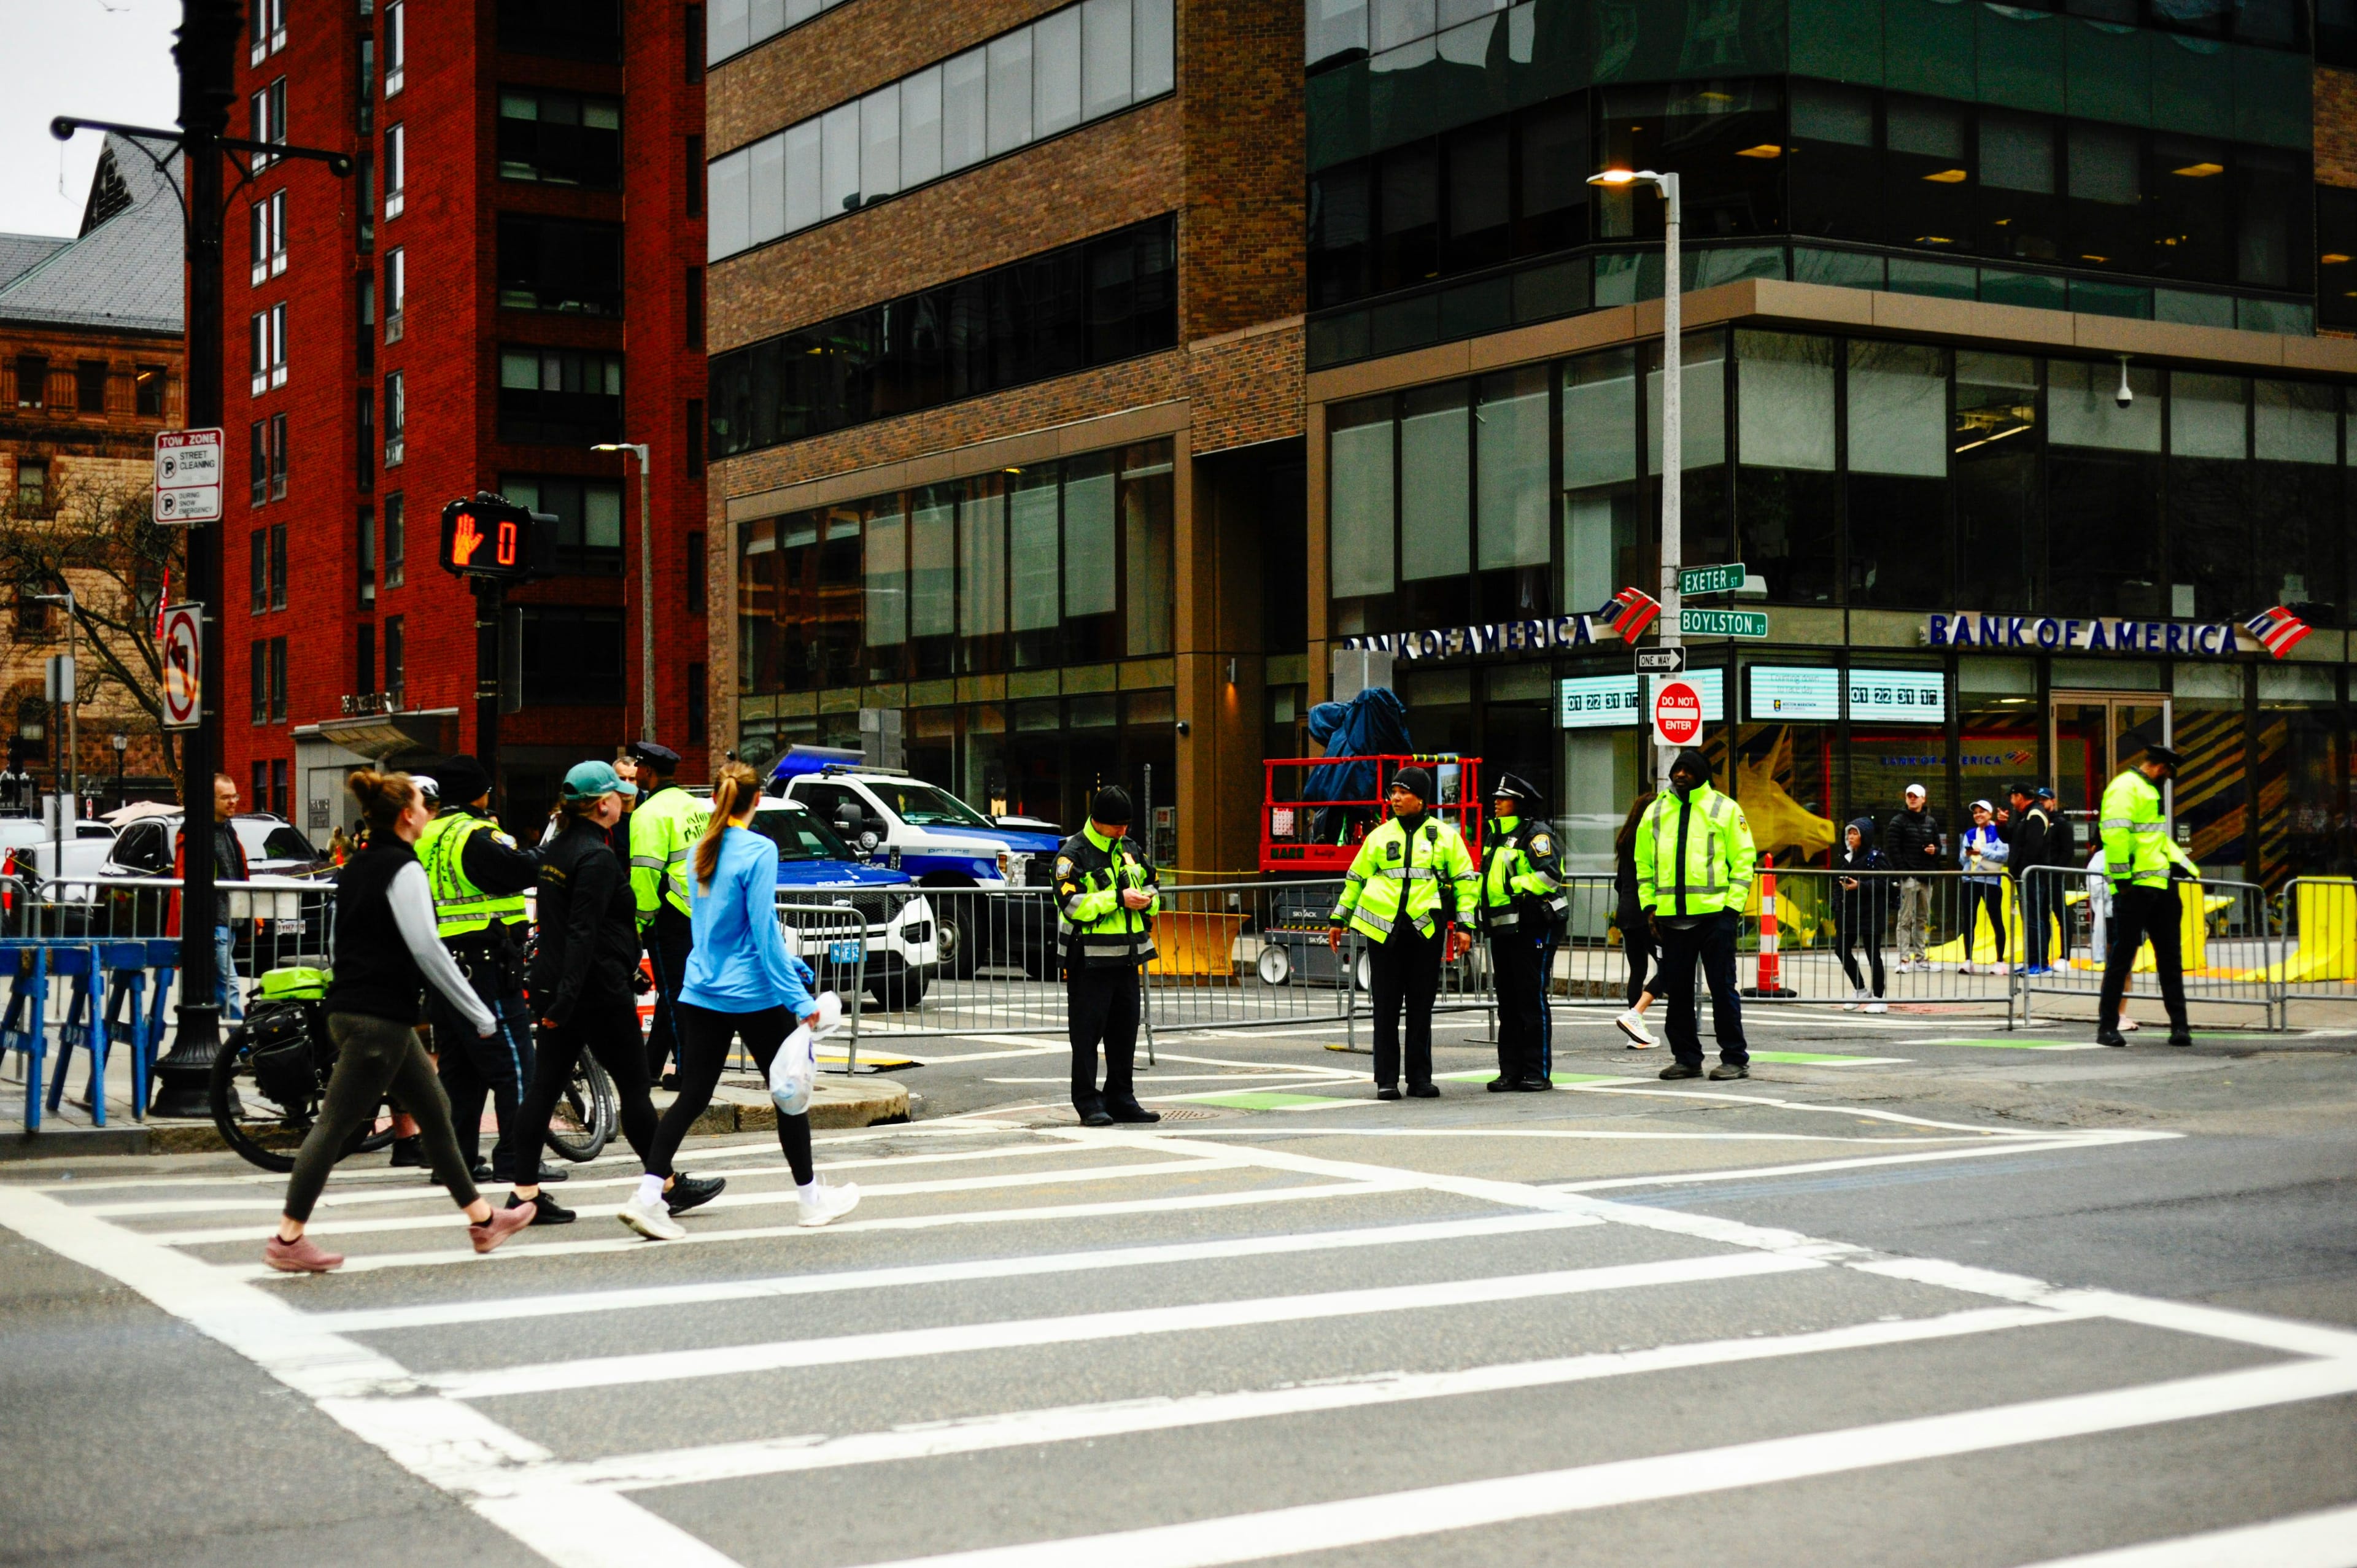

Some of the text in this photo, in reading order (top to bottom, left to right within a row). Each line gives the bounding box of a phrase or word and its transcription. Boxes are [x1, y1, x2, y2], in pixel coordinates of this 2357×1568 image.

[161, 433, 217, 447] TOW ZONE
[179, 450, 207, 460] STREET
[179, 460, 215, 470] CLEANING
[179, 506, 212, 515] EMERGENCY
[498, 522, 516, 564] 0
[1685, 570, 1738, 593] EXETER ST
[1682, 612, 1764, 634] BOYLSTON ST
[1420, 629, 1458, 658] OF
[1461, 615, 1596, 654] AMERICA
[1929, 615, 2239, 654] BANK OF AMERICA
[1641, 655, 1671, 665] ONE WAY
[1568, 696, 1581, 710] 01
[1587, 695, 1600, 709] 22
[1606, 693, 1619, 709] 31
[1662, 696, 1695, 706] DO NOT
[1851, 688, 1867, 702] 01
[1875, 689, 1891, 703] 22
[1898, 689, 1914, 704] 31
[1665, 720, 1692, 730] ENTER
[1881, 755, 2002, 765] BANK OF AERICA
[1309, 935, 1329, 944] SKYJAC
